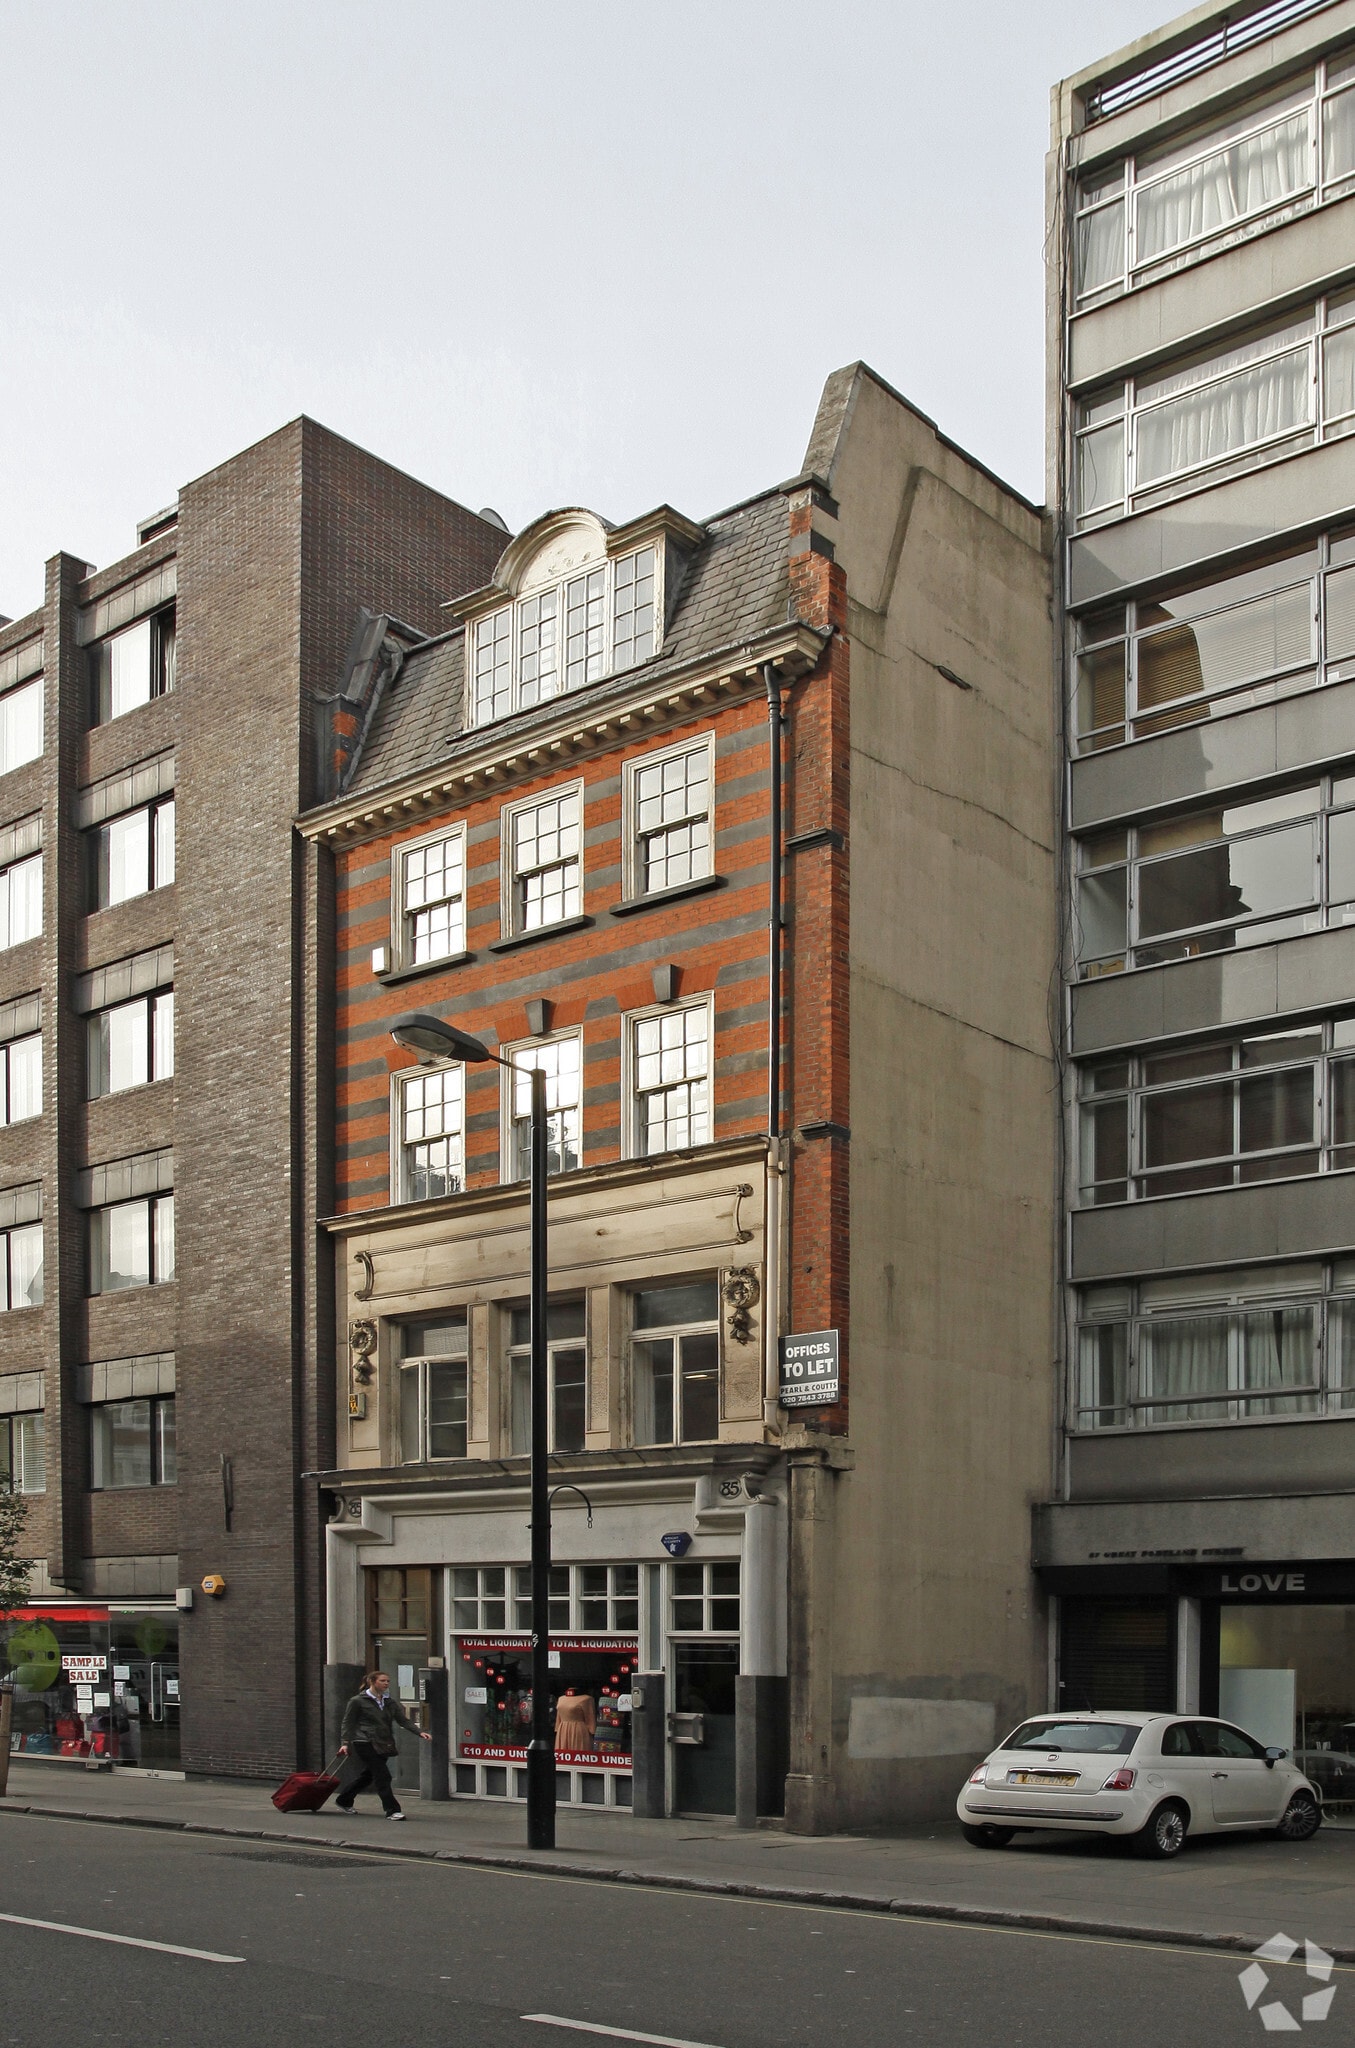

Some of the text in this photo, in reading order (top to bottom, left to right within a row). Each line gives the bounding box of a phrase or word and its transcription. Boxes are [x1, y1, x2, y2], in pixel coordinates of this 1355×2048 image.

[786, 1342, 830, 1358] OFFICES
[782, 1358, 834, 1378] TO LET
[780, 1386, 802, 1394] PEARL
[812, 1382, 837, 1390] COUTTS
[721, 1482, 740, 1496] 85
[1220, 1574, 1305, 1592] LOVE
[490, 1640, 532, 1648] LIQUIDATI
[582, 1640, 638, 1649] LIQUIDATION
[63, 1658, 105, 1668] SAMPLE
[70, 1671, 98, 1680] SALE
[484, 1748, 506, 1757] AND
[574, 1754, 598, 1762] AND
[602, 1756, 632, 1765] UNDE
